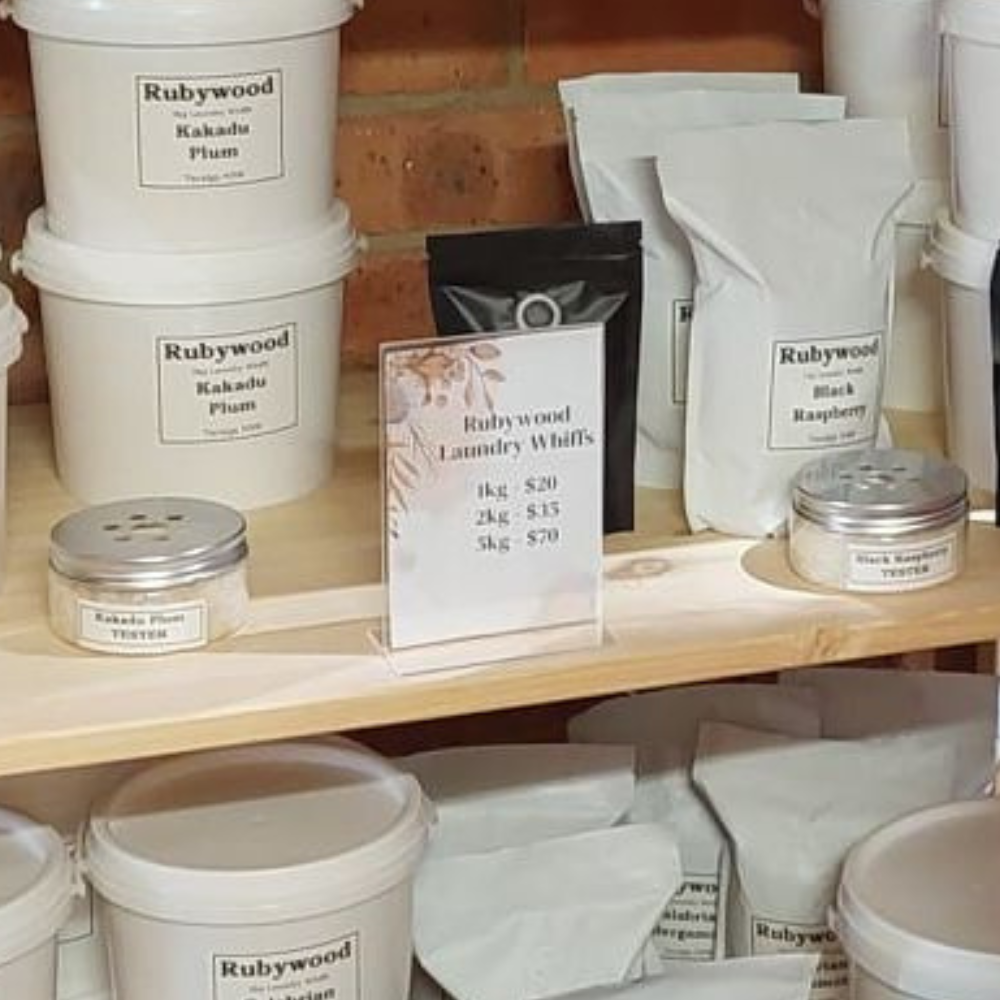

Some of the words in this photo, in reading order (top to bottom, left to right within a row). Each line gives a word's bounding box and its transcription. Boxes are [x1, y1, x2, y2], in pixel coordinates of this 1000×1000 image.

[143, 75, 273, 107] Rubywood
[175, 121, 249, 138] Kakadu
[188, 144, 238, 160] Plum
[164, 330, 289, 364] Rubywood
[779, 337, 880, 367] Rubywood
[196, 376, 267, 396] Kakadu
[813, 382, 854, 401] Black
[209, 400, 257, 416] Plum
[793, 405, 867, 424] Raspberry
[464, 405, 570, 435] Rubywood
[439, 437, 521, 461] Laundry
[531, 428, 595, 451] Whiffs
[524, 475, 558, 495] $20
[476, 508, 511, 528] 2kg
[526, 528, 560, 547] $70
[881, 563, 929, 579] TESTER
[95, 612, 146, 626] Kakadu
[111, 628, 168, 641] TESTER
[221, 941, 351, 981] Rubywood
